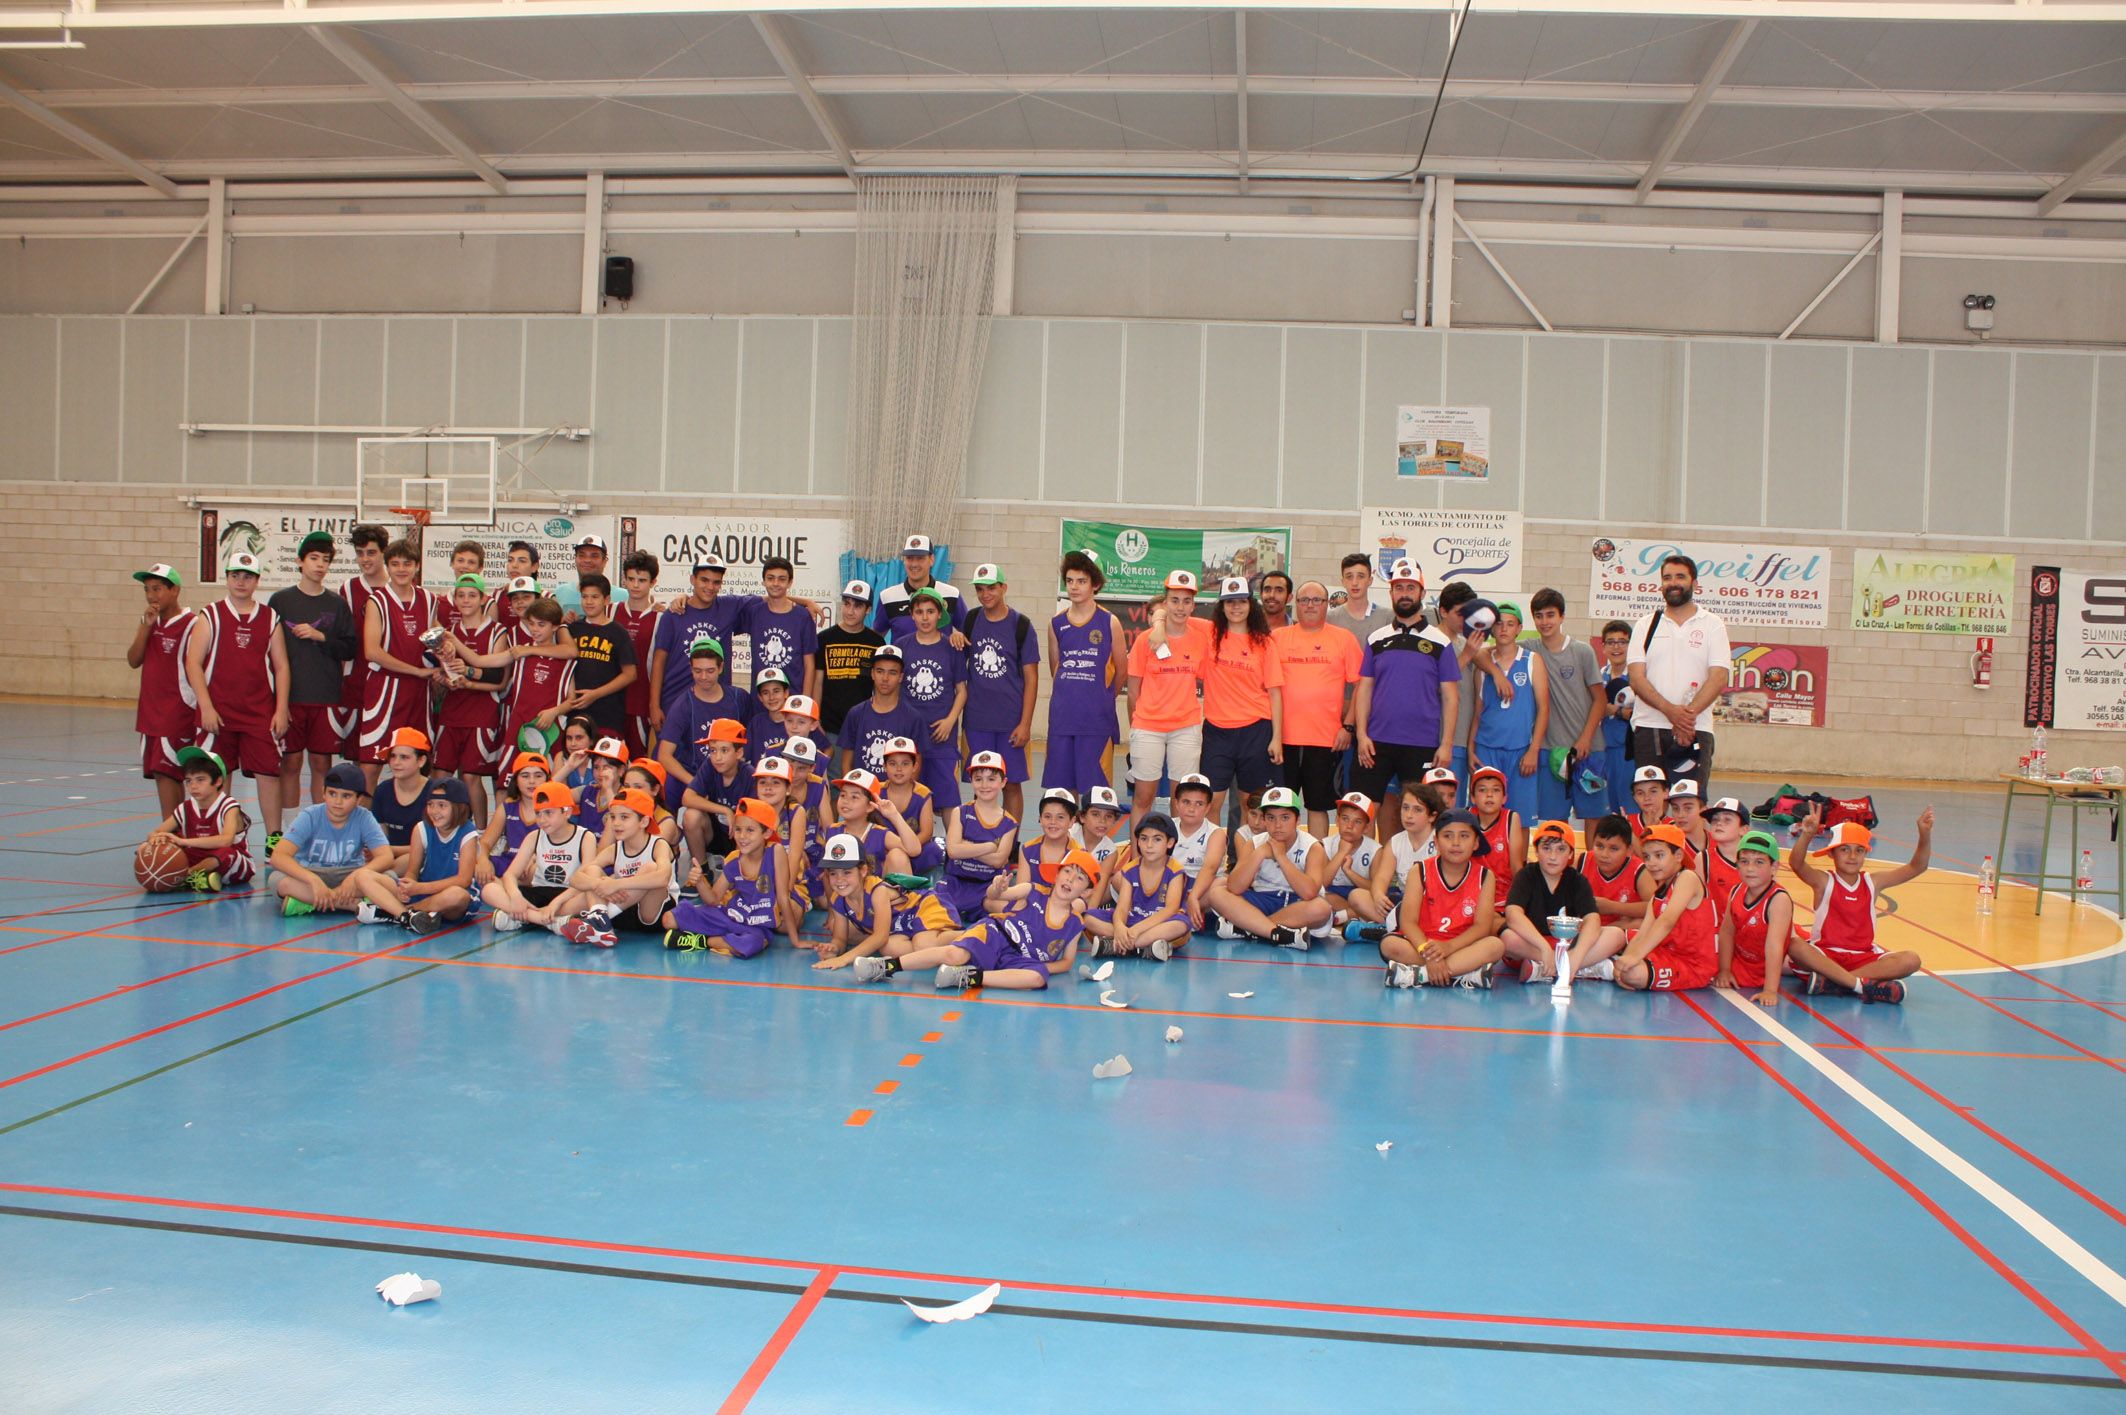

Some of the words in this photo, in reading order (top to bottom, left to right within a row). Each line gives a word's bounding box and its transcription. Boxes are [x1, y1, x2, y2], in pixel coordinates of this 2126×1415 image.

[1378, 510, 1415, 518] EXCMO.
[1418, 511, 1493, 521] AYUNTAMIENTO
[281, 517, 300, 532] EL
[703, 522, 771, 533] ASADOR
[1402, 520, 1439, 528] TORRES
[1456, 521, 1504, 529] COTILLAS
[1498, 537, 1512, 547] de
[663, 533, 808, 566] CASADUQUE
[1448, 548, 1510, 564] DEPORTES
[1631, 544, 1822, 587] Poeiffel
[798, 589, 813, 597] 223
[1602, 581, 1632, 592] 968
[1719, 586, 1749, 598] 606
[1755, 588, 1785, 599] 178
[1790, 589, 1819, 600] 821
[1907, 589, 2004, 605] DROGUERÍA
[1596, 594, 1631, 602] REFORMAS
[1637, 596, 1665, 604] DECORAC
[1788, 602, 1822, 610] VIVIENDAS
[1610, 610, 1644, 618] Blasco
[1743, 616, 1777, 625] Parque
[1780, 618, 1821, 626] Emisora
[1708, 607, 1740, 616] AZULEJOS
[1747, 609, 1788, 617] PAVIMENTOS
[1903, 604, 2006, 619] FERRETERÍA
[687, 622, 719, 634] BASKET
[1862, 619, 1870, 628] La
[1894, 621, 1905, 629] Las
[1906, 621, 1924, 630] Torres
[1925, 622, 1933, 630] de
[1971, 624, 1982, 633] 968
[1983, 625, 1995, 633] 626
[1996, 625, 2007, 634] 846
[2032, 603, 2043, 642] OFICIAL
[2045, 603, 2056, 643] TORRES
[579, 650, 611, 662] ERSIDAD
[732, 651, 751, 661] 968
[829, 646, 859, 659] FORMULA
[2044, 644, 2055, 665] LAS
[829, 657, 845, 668] TEST
[911, 658, 943, 672] BASKET
[2065, 668, 2081, 676] Ctra.
[2083, 668, 2124, 677] Alcantarilla
[2028, 643, 2042, 722] PATROCINADOR
[2068, 676, 2081, 684] Telf.
[2099, 677, 2110, 685] 38
[2111, 677, 2121, 685] 81
[917, 685, 945, 701] TORRES
[1794, 694, 1815, 702] Mayor
[2042, 664, 2054, 722] DEPORTIVO
[2086, 713, 2110, 721] 30565
[2111, 713, 2125, 721] LAS
[764, 737, 786, 748] BASK
[1197, 832, 1205, 846] 4
[1095, 849, 1110, 861] 18
[1361, 852, 1370, 867] 6
[1439, 917, 1452, 933] 2
[1655, 967, 1673, 989] 50
